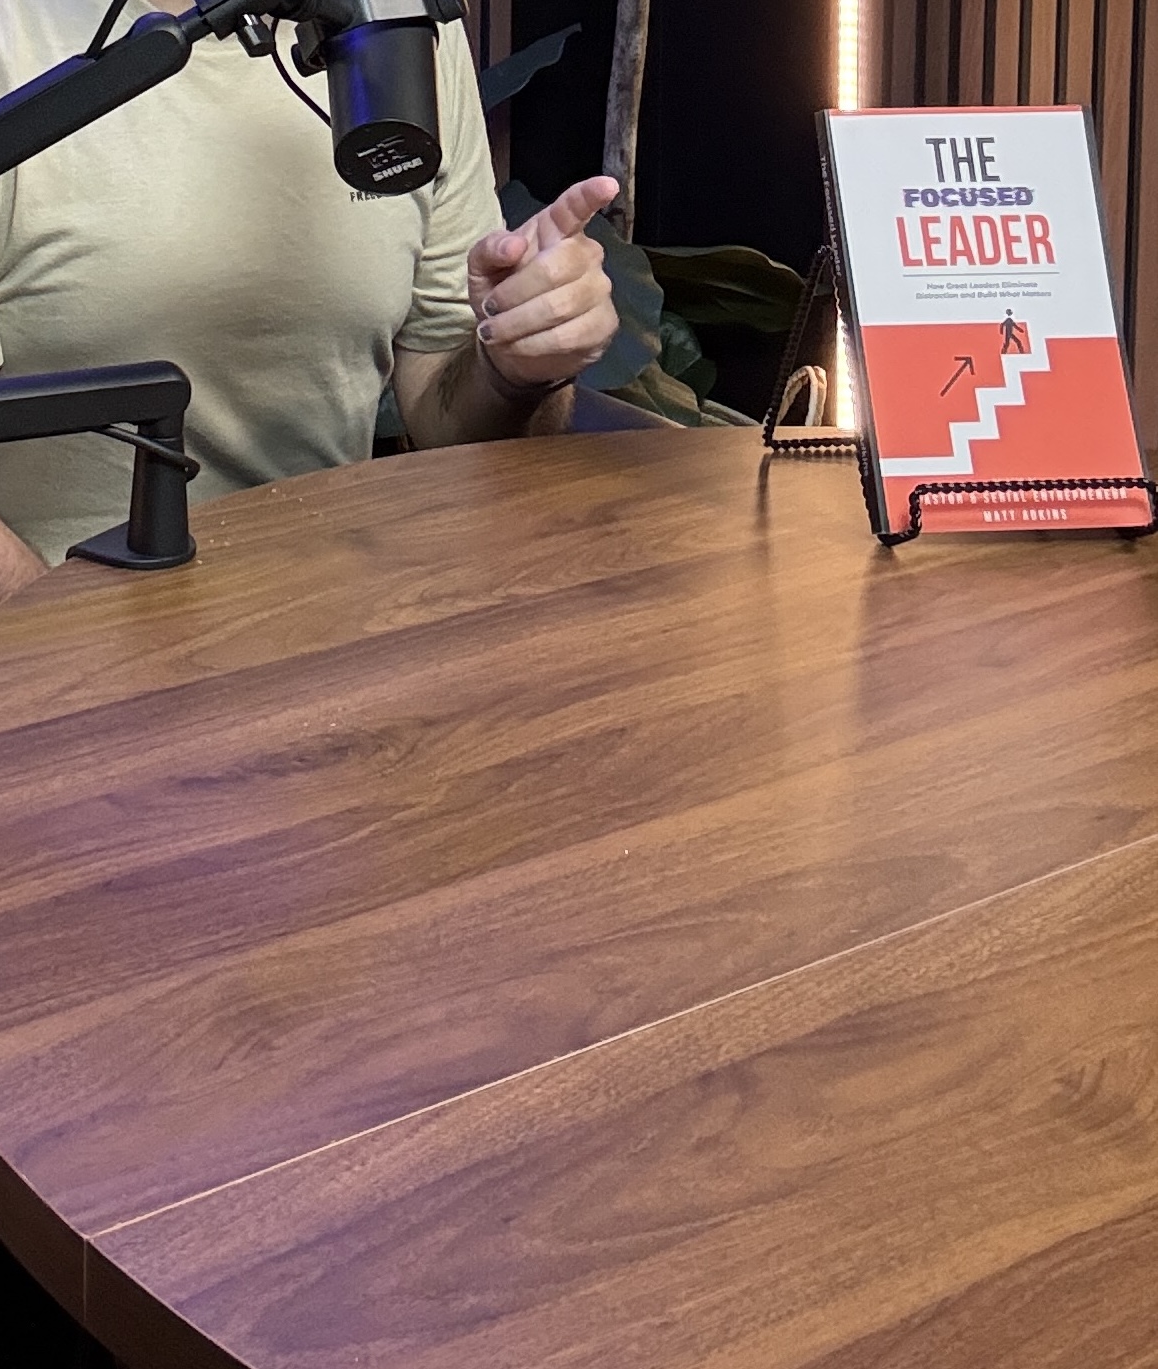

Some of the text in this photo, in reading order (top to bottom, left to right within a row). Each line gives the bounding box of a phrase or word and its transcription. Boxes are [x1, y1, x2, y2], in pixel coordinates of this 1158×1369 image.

[372, 156, 424, 182] SHURE
[925, 137, 1002, 183] THE
[902, 186, 1035, 208] FOCUSED
[896, 214, 1056, 268] LEADER
[921, 492, 964, 506] ASTOR
[982, 508, 1068, 523] MATT ADKINS
